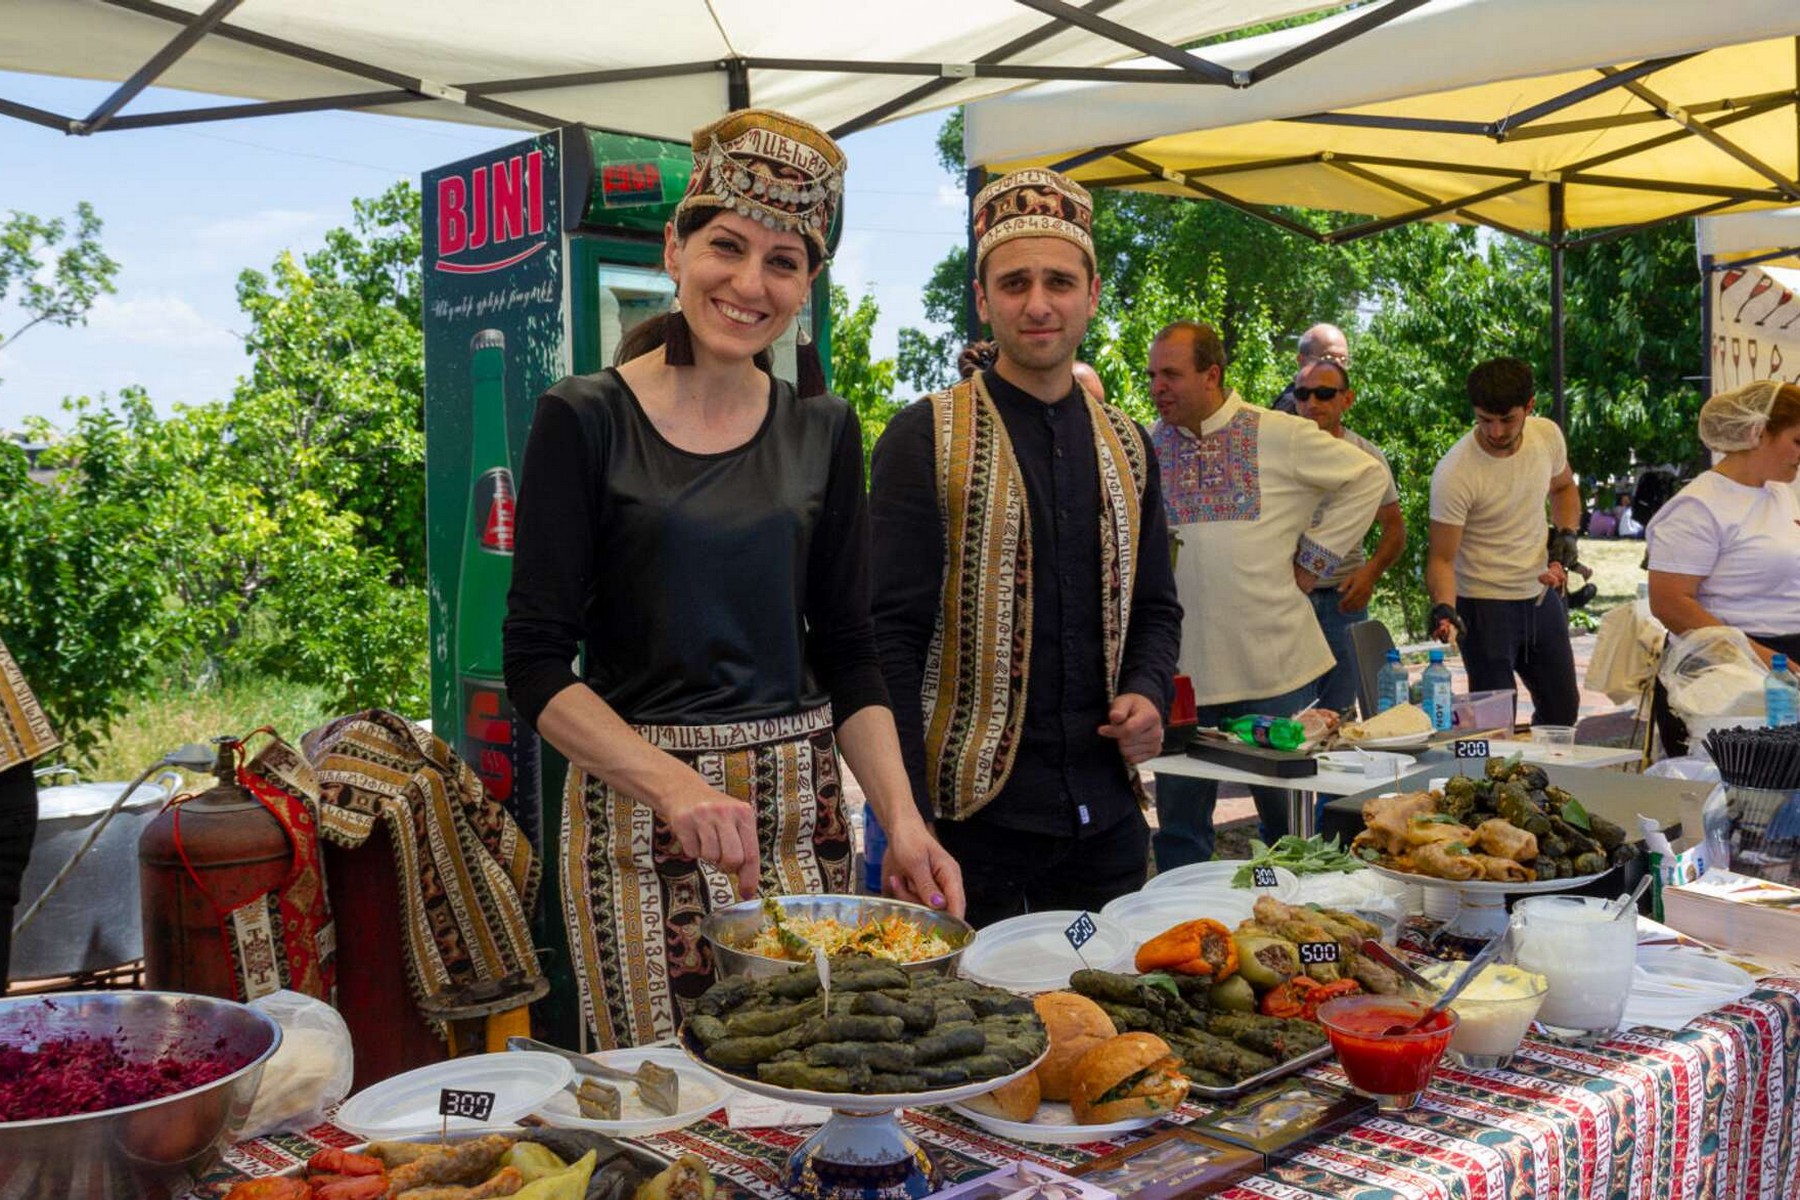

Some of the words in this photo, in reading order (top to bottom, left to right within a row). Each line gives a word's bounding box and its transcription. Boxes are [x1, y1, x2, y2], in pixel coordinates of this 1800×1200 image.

[438, 150, 545, 257] BJNI
[1457, 741, 1487, 757] 200
[1255, 867, 1276, 886] 300
[1068, 916, 1094, 946] 250
[1301, 943, 1336, 963] 500
